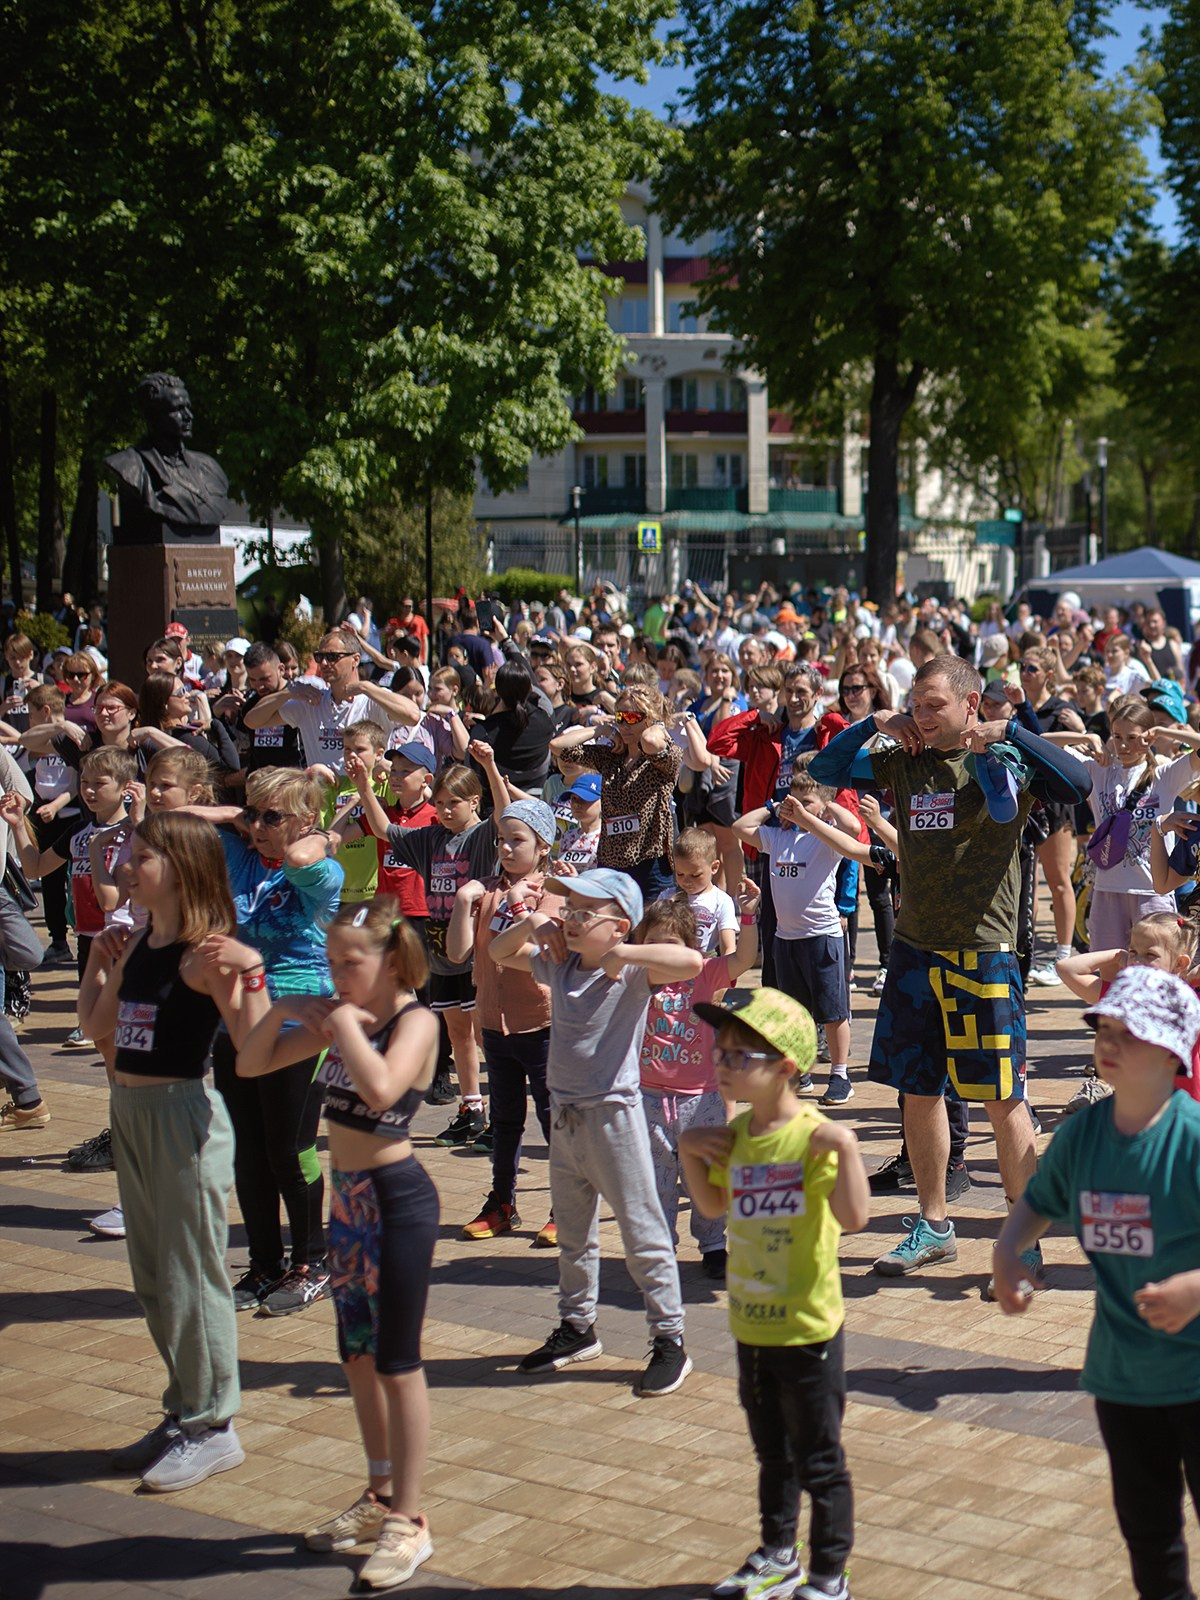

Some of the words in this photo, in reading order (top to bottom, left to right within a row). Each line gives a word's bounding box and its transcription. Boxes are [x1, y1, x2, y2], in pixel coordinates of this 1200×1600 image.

[257, 735, 280, 746] 682
[321, 739, 344, 750] 399
[1131, 807, 1156, 820] 98
[612, 820, 634, 833] 810
[915, 812, 949, 829] 626
[564, 851, 588, 862] 807
[779, 865, 799, 878] 818
[433, 878, 453, 891] 478
[739, 1192, 799, 1218] 044
[1094, 1223, 1144, 1251] 556
